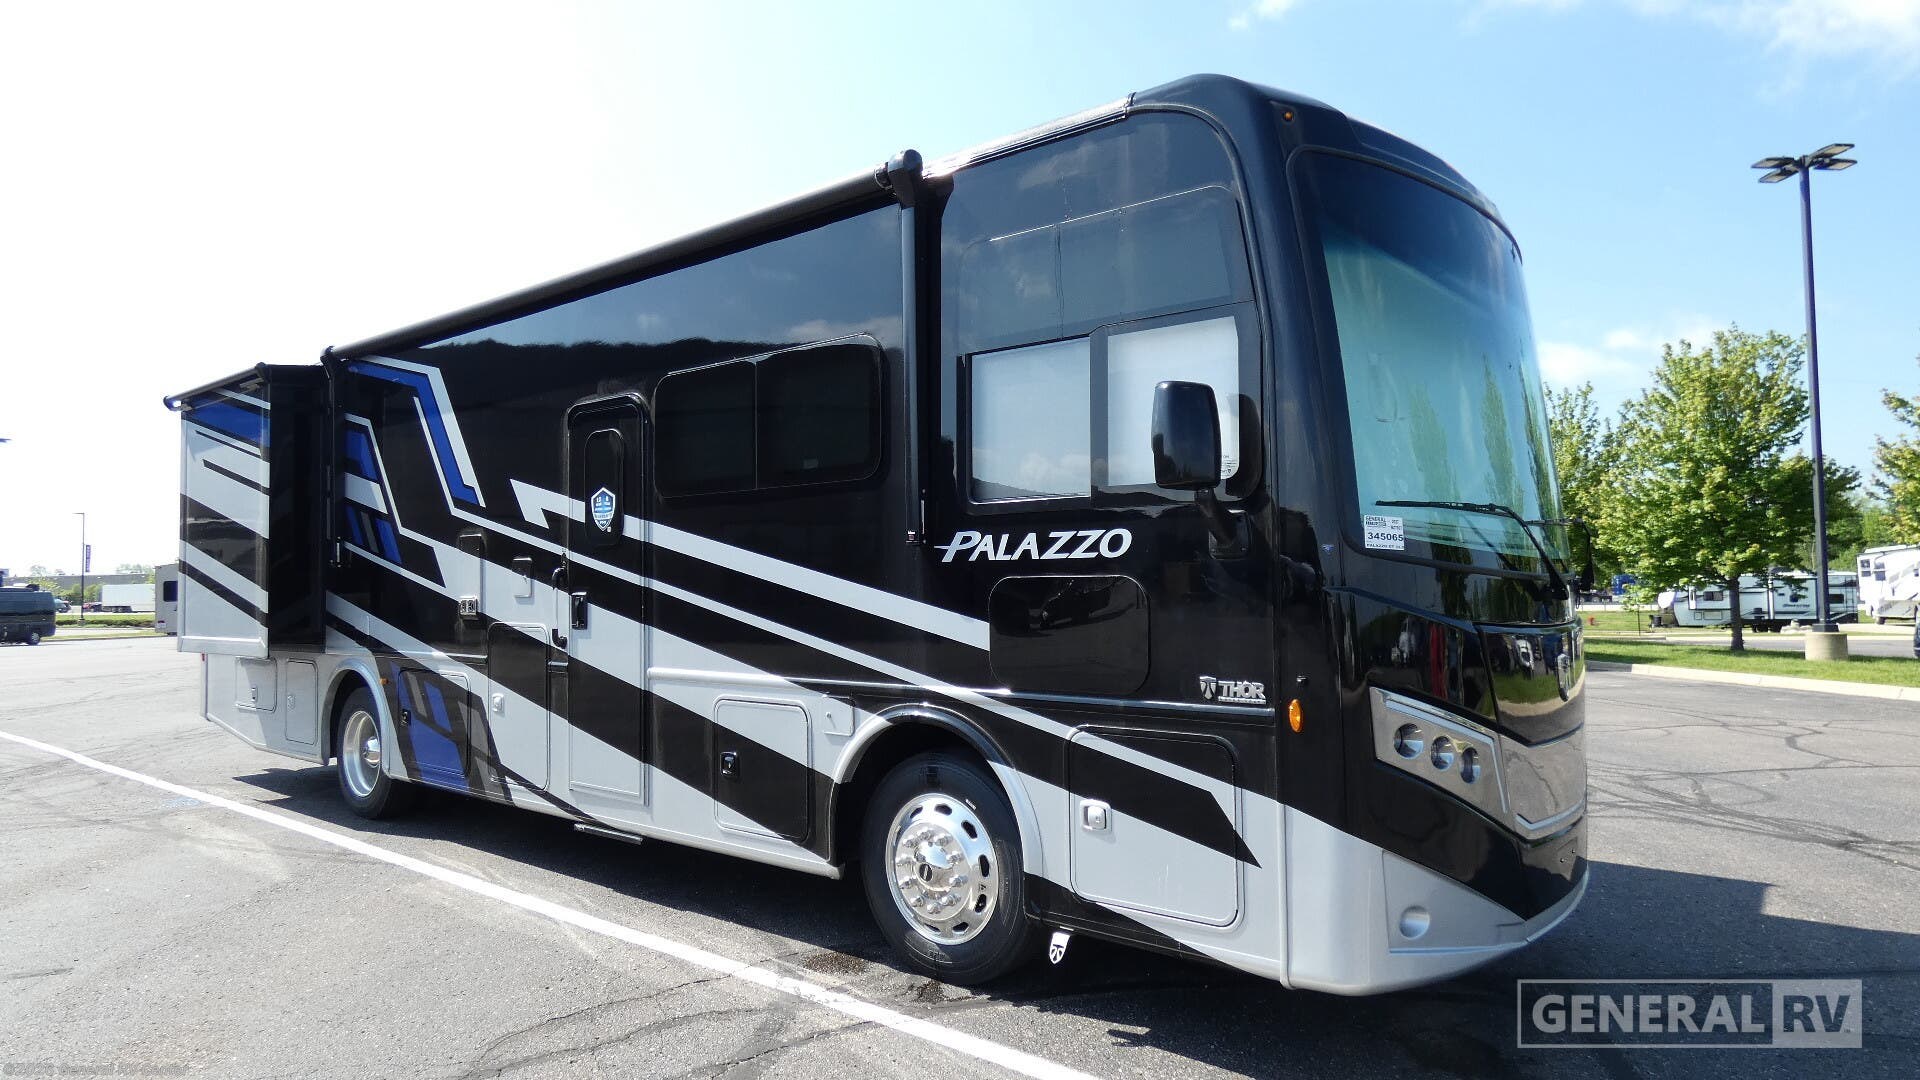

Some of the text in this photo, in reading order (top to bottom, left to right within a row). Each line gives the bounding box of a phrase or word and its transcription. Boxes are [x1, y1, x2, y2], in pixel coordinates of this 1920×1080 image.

[934, 528, 1132, 562] PALAZZO
[1367, 532, 1404, 541] 345065
[1218, 680, 1266, 699] THOR
